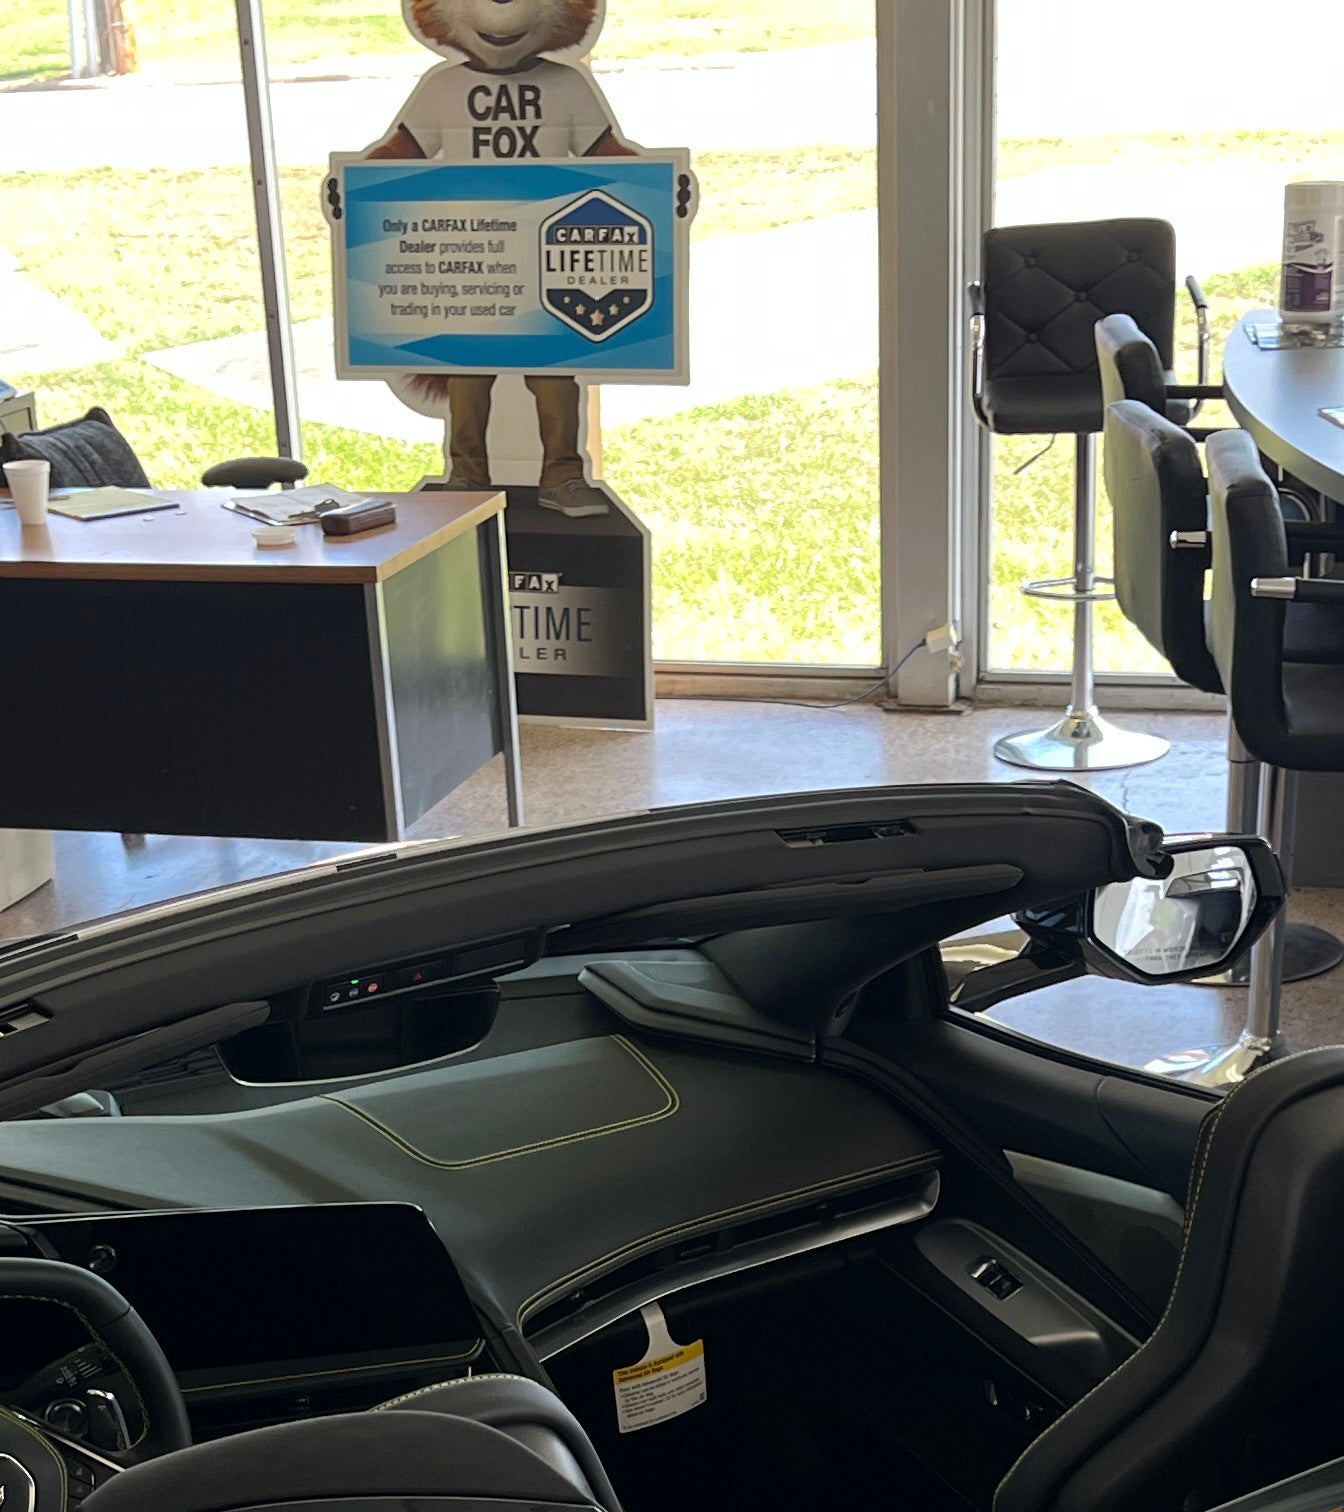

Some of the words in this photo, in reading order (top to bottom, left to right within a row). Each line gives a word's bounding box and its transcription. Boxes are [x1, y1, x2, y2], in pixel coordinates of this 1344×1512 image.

[467, 84, 542, 121] CAR
[473, 125, 541, 158] FOX
[382, 219, 408, 234] Only
[411, 221, 418, 232] a
[422, 219, 467, 232] CARFAX
[470, 219, 517, 232] Lifetime
[555, 227, 639, 244] CARFAX
[399, 240, 436, 253] Dealer
[439, 240, 484, 255] provides
[487, 240, 505, 253] full
[385, 263, 422, 274] access
[424, 261, 436, 274] to
[438, 261, 484, 274] CARFAX
[487, 262, 517, 274] when
[546, 250, 648, 272] LIFETIME
[567, 276, 629, 285] DEALER
[378, 284, 398, 297] you
[400, 284, 418, 295] are
[420, 282, 460, 297] buying,
[462, 282, 510, 297] servicing
[512, 284, 526, 295] or
[391, 303, 428, 318] trading
[431, 303, 441, 316] in
[443, 305, 467, 318] your
[470, 303, 496, 316] used
[498, 305, 516, 316] car
[513, 573, 558, 593] FAX
[513, 605, 592, 642] TIME
[519, 647, 567, 661] LER
